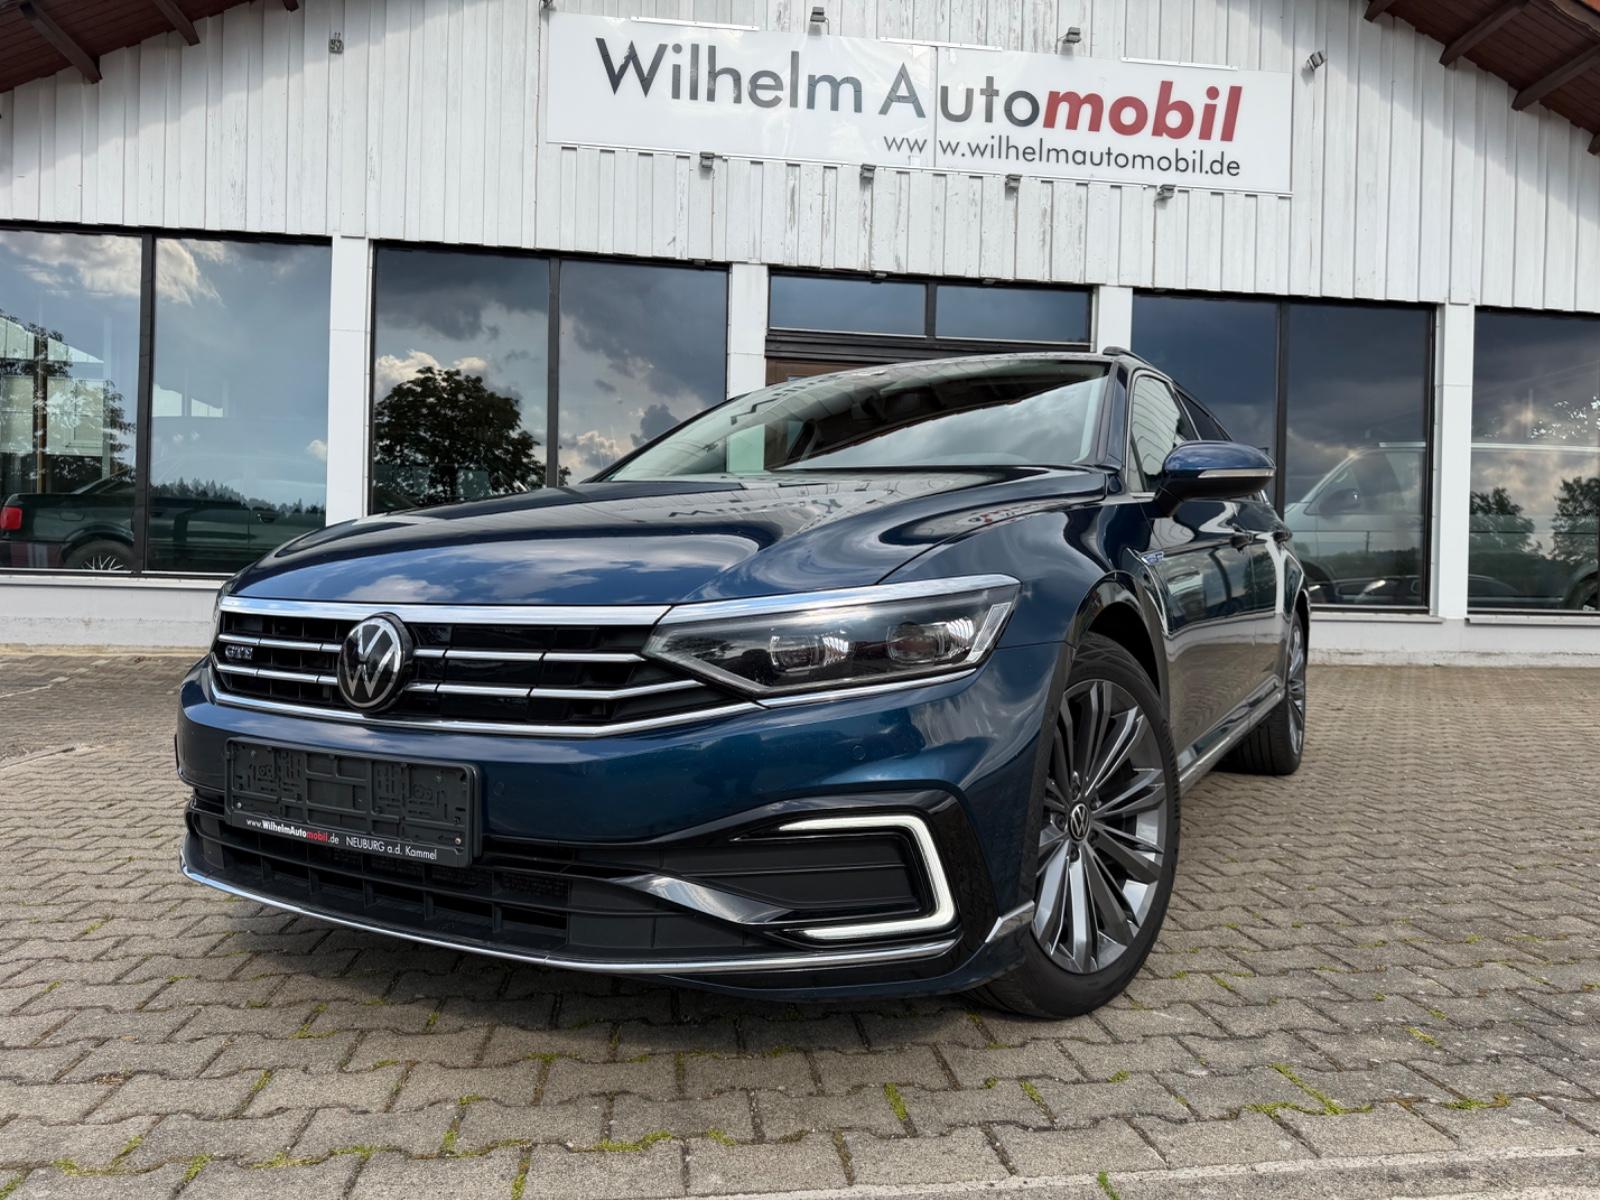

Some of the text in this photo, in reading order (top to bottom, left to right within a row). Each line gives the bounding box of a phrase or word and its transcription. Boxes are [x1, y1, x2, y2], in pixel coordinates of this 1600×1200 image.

[595, 37, 1243, 142] Wilhelm Automobil
[884, 135, 1241, 177] www.wilhelmautomobil.de
[246, 819, 437, 860] www.WilhelmAutomobil.de NEUBURG a.d. Kammel
